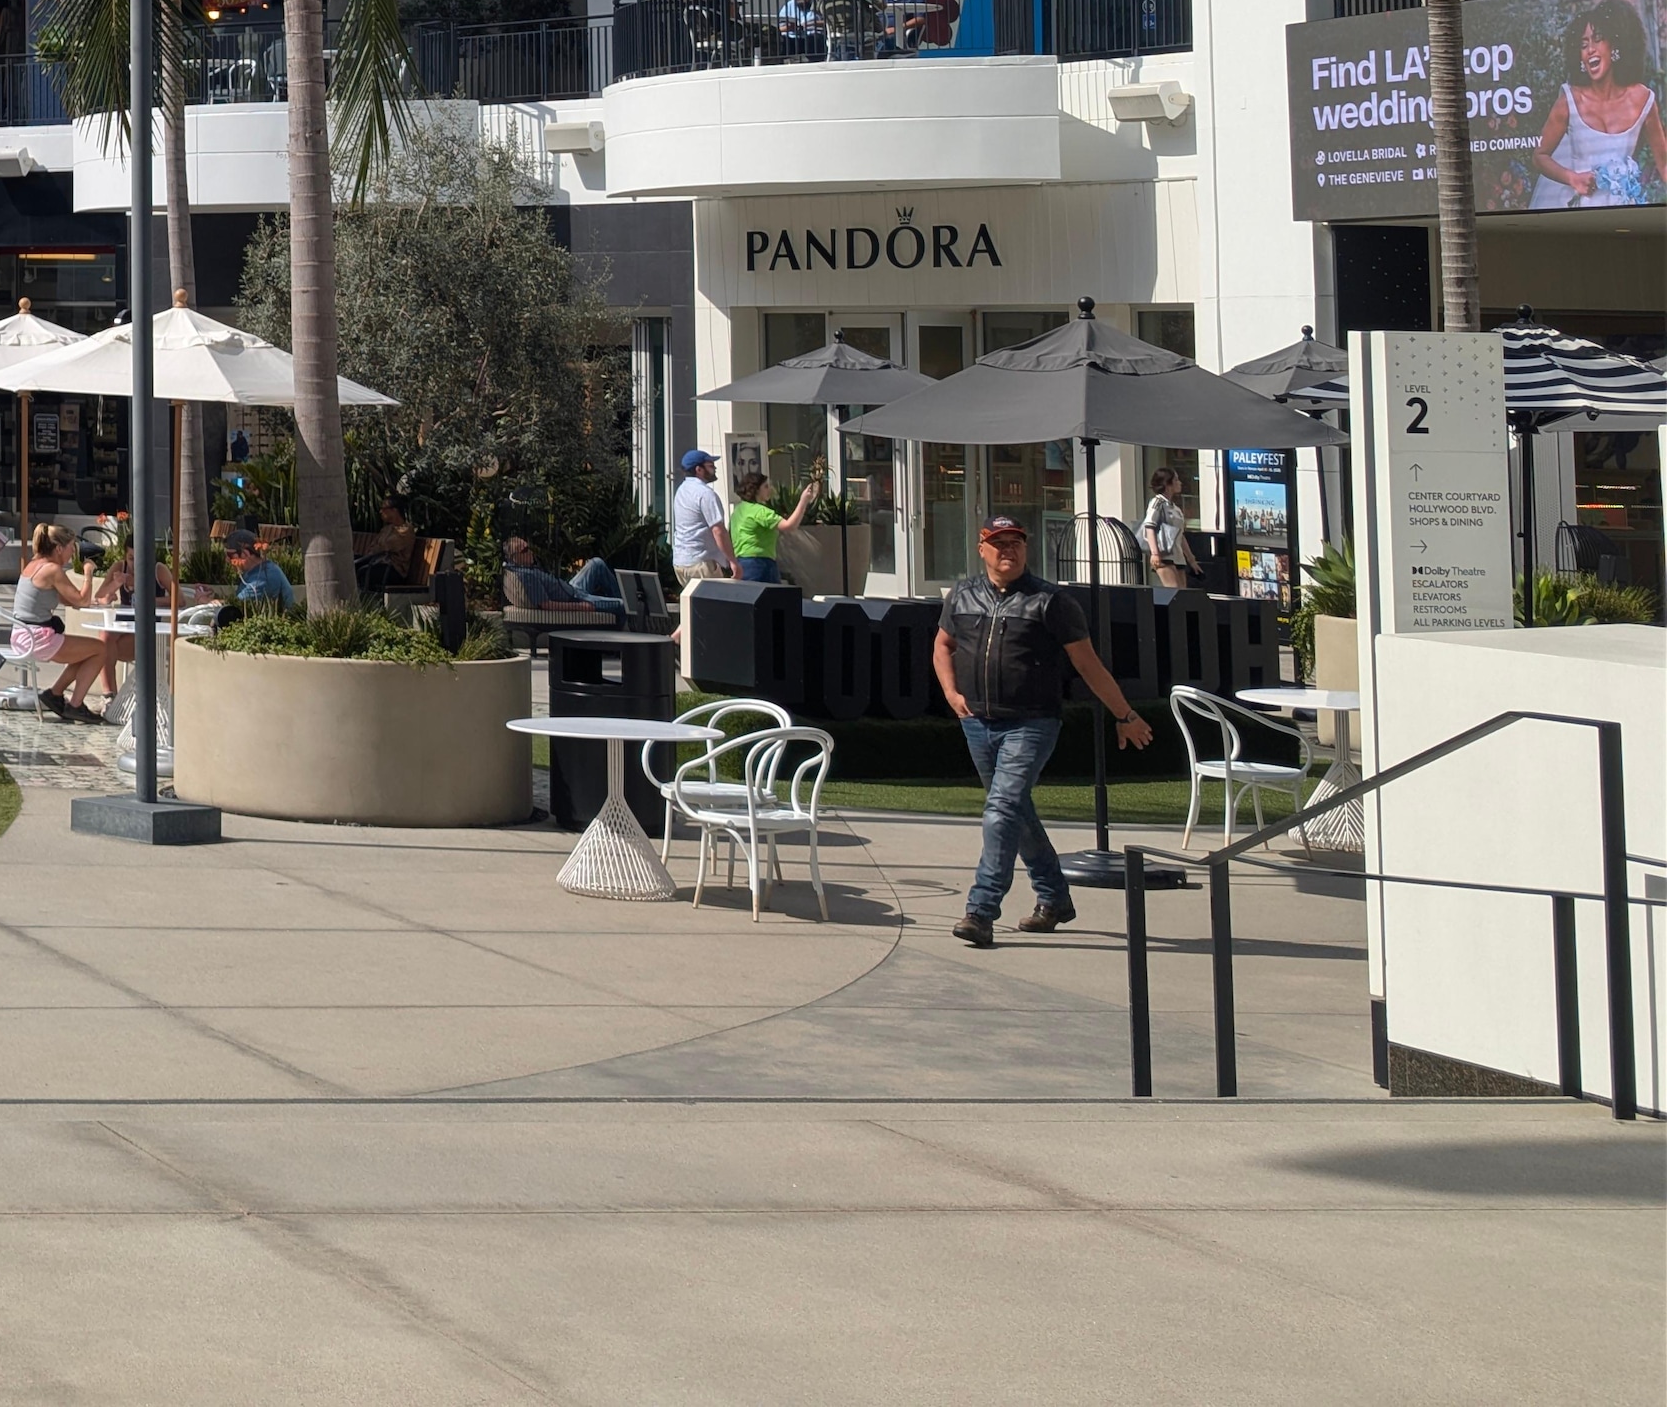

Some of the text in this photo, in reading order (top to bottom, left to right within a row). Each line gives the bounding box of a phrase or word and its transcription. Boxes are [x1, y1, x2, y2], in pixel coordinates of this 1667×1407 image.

[1312, 49, 1376, 90] Find
[1385, 46, 1430, 83] LA'
[1328, 149, 1370, 163] LOVELLA
[1372, 146, 1407, 160] BRIDAL
[1489, 135, 1543, 151] COMPANY
[1328, 170, 1404, 186] THE GENEVIEVE
[746, 223, 1002, 272] PANDORA
[1405, 385, 1431, 394] LEVEL
[1406, 397, 1429, 434] 2
[1233, 452, 1285, 466] PALEYFEST
[1408, 492, 1501, 502] CENTER COURTYARD
[1409, 504, 1497, 514] HOLLYWOOD BLVD.
[1409, 517, 1483, 527] SHOPS & DINING
[1424, 566, 1486, 577] Dolby Theatre
[1412, 579, 1469, 589] ESCALATORS
[1412, 592, 1462, 601] ELEVATORS
[1413, 605, 1467, 614] RESTROOMS
[1413, 618, 1505, 628] ALL PARKING LEVELS
